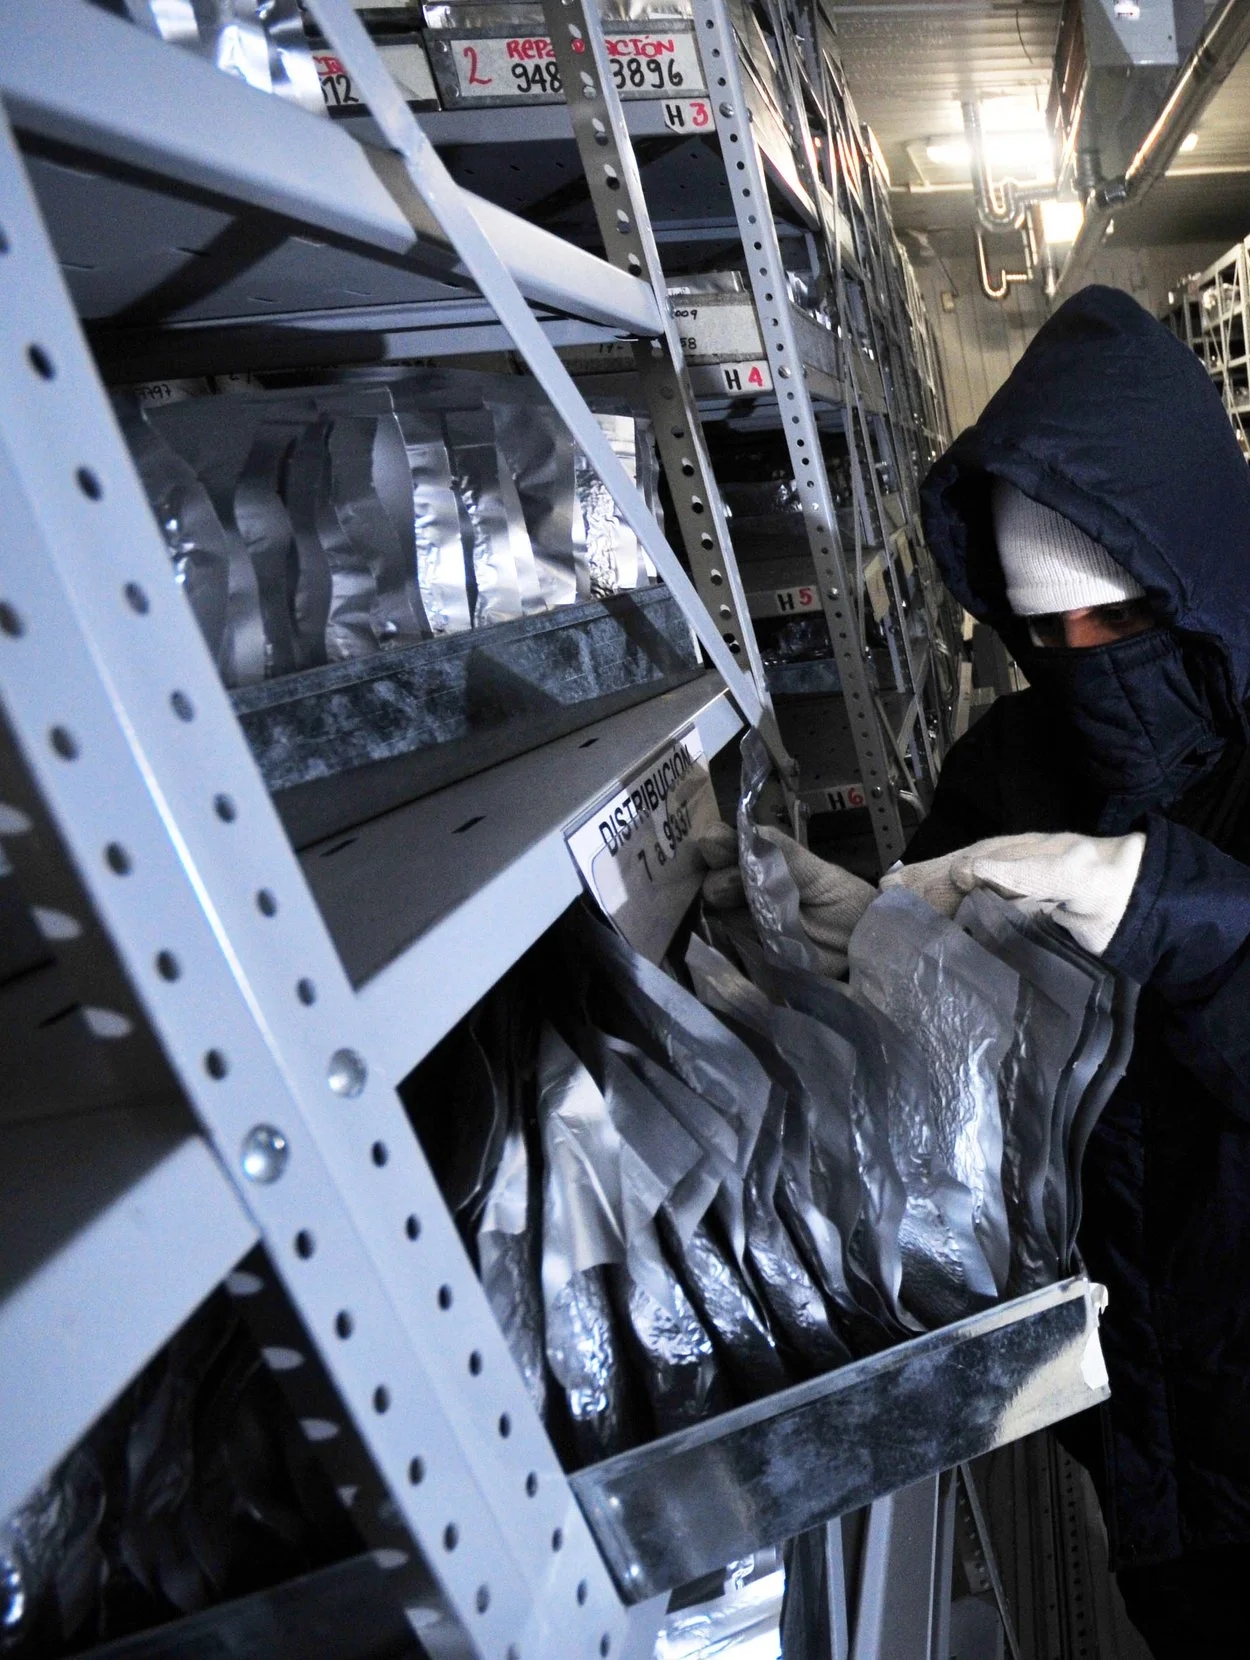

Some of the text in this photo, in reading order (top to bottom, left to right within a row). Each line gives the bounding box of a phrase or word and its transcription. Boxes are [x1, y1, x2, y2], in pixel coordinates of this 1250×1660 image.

[463, 46, 492, 85] 2
[598, 743, 694, 857] DISTRIBUCIÓN
[637, 849, 653, 882] 7
[655, 842, 667, 866] a
